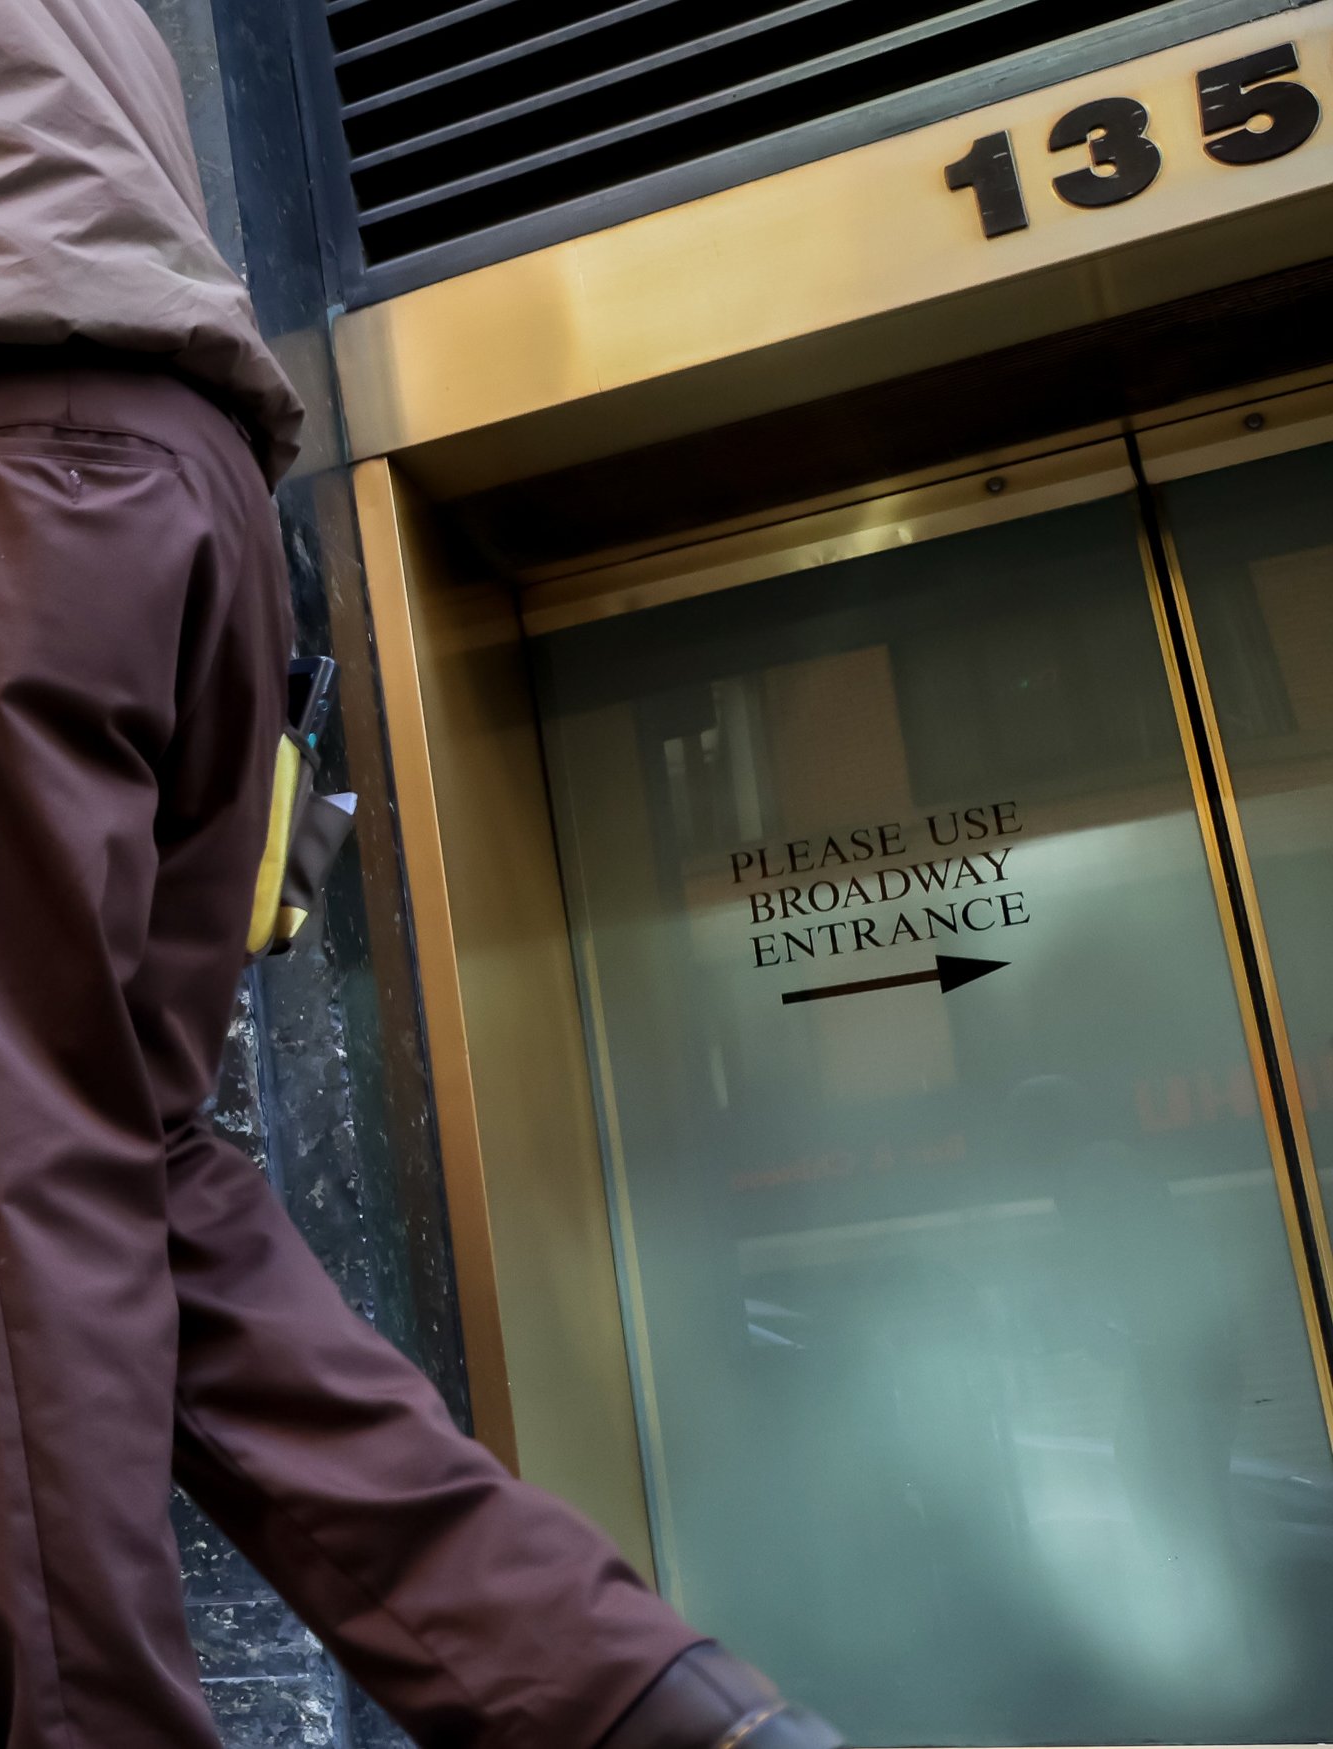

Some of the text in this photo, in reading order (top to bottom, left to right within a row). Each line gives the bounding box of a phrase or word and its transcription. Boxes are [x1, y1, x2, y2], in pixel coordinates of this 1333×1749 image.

[944, 41, 1323, 240] 135
[730, 801, 1023, 884] PLEASE USE
[748, 846, 1014, 925] BROADWAY
[749, 891, 1031, 968] ENTRANCE
